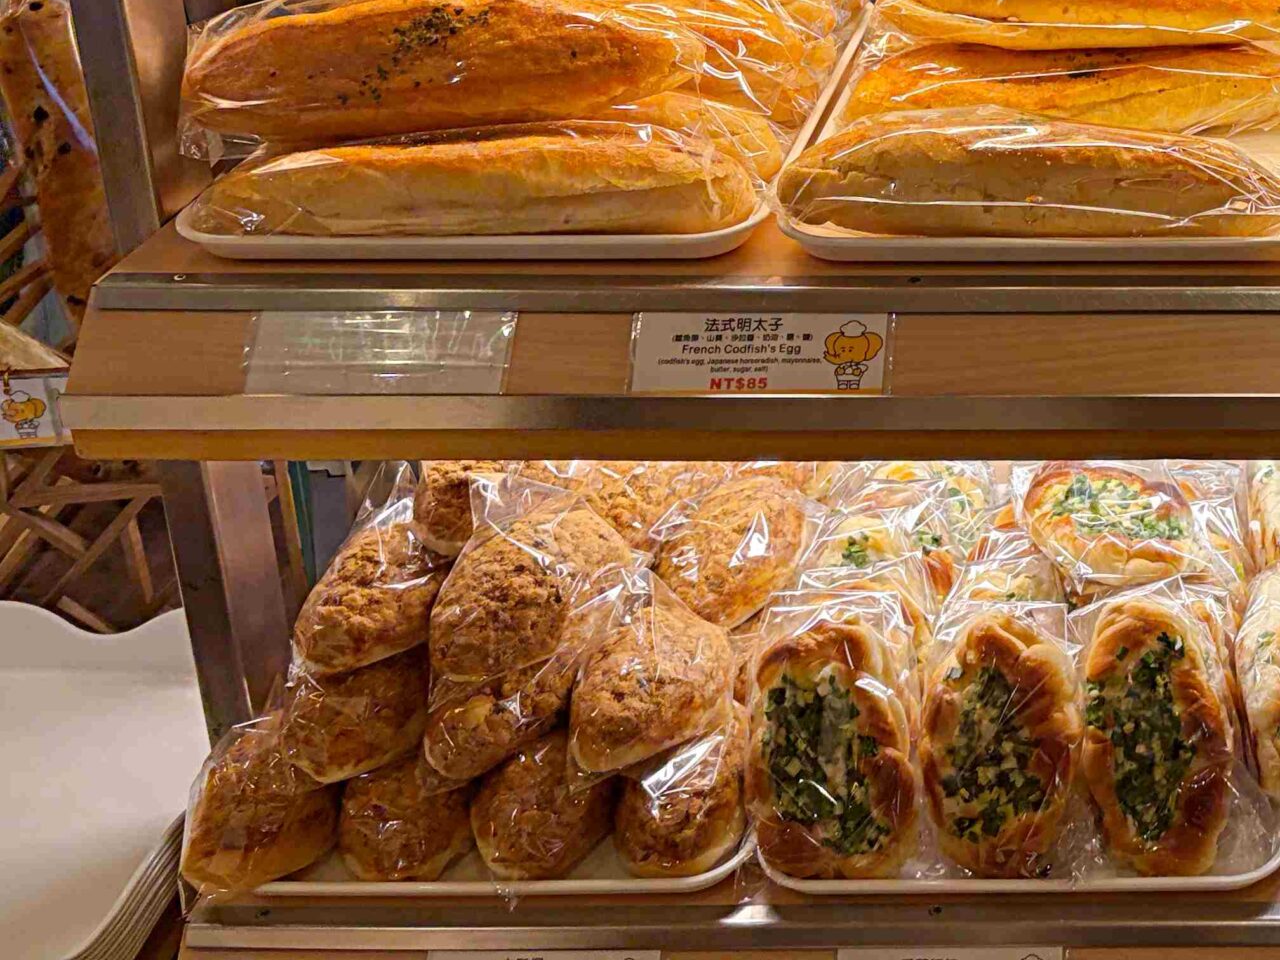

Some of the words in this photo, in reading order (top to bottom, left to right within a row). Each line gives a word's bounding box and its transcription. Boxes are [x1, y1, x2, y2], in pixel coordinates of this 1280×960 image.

[705, 318, 783, 332] 法式明太子
[682, 344, 721, 354] French
[724, 343, 776, 354] Codfish's
[779, 343, 801, 355] Egg
[709, 377, 767, 390] NT$85
